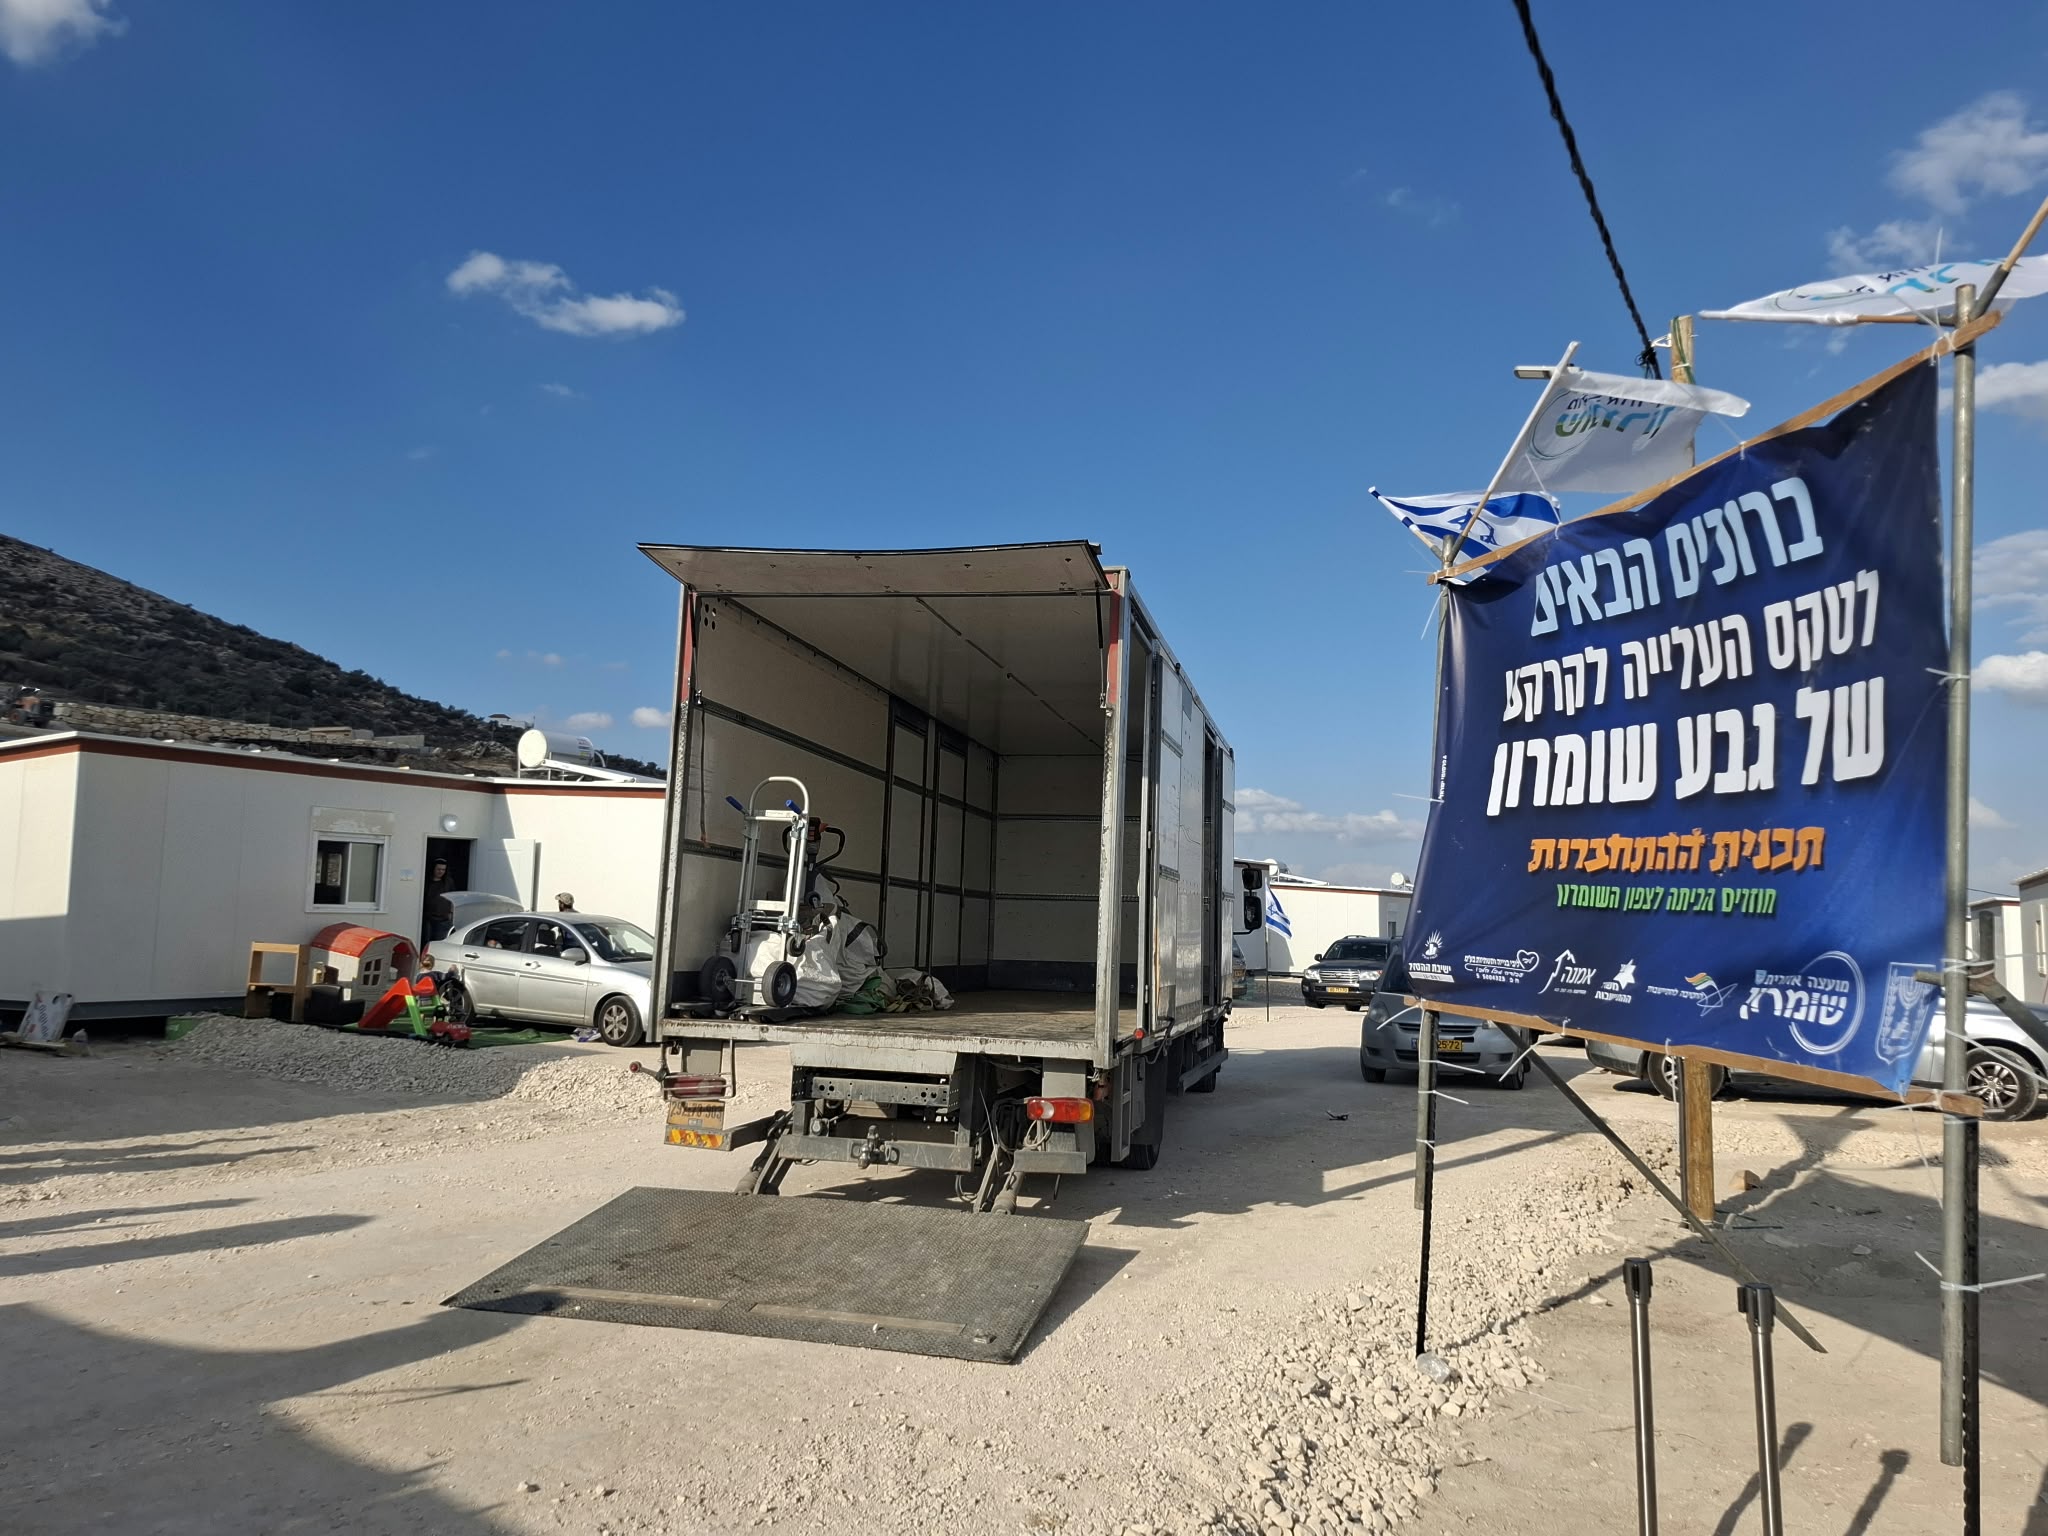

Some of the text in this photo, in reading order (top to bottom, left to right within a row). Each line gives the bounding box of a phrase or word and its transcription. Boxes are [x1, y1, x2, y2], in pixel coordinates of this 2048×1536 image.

[1530, 477, 1823, 637] ברוכים הבאים
[1503, 570, 1879, 723] לטקס העלייה לקרקע
[1487, 677, 1885, 817] של גבע שומרון
[1527, 826, 1825, 873] תכנית ההתחברות
[1557, 883, 1777, 914] חוזרים הביתה לצפון השומרון
[1432, 964, 1452, 974] ישיבת
[1560, 966, 1597, 985] אמנה
[1764, 974, 1849, 993] מועצה אזורית
[1740, 987, 1848, 1025] שומרון
